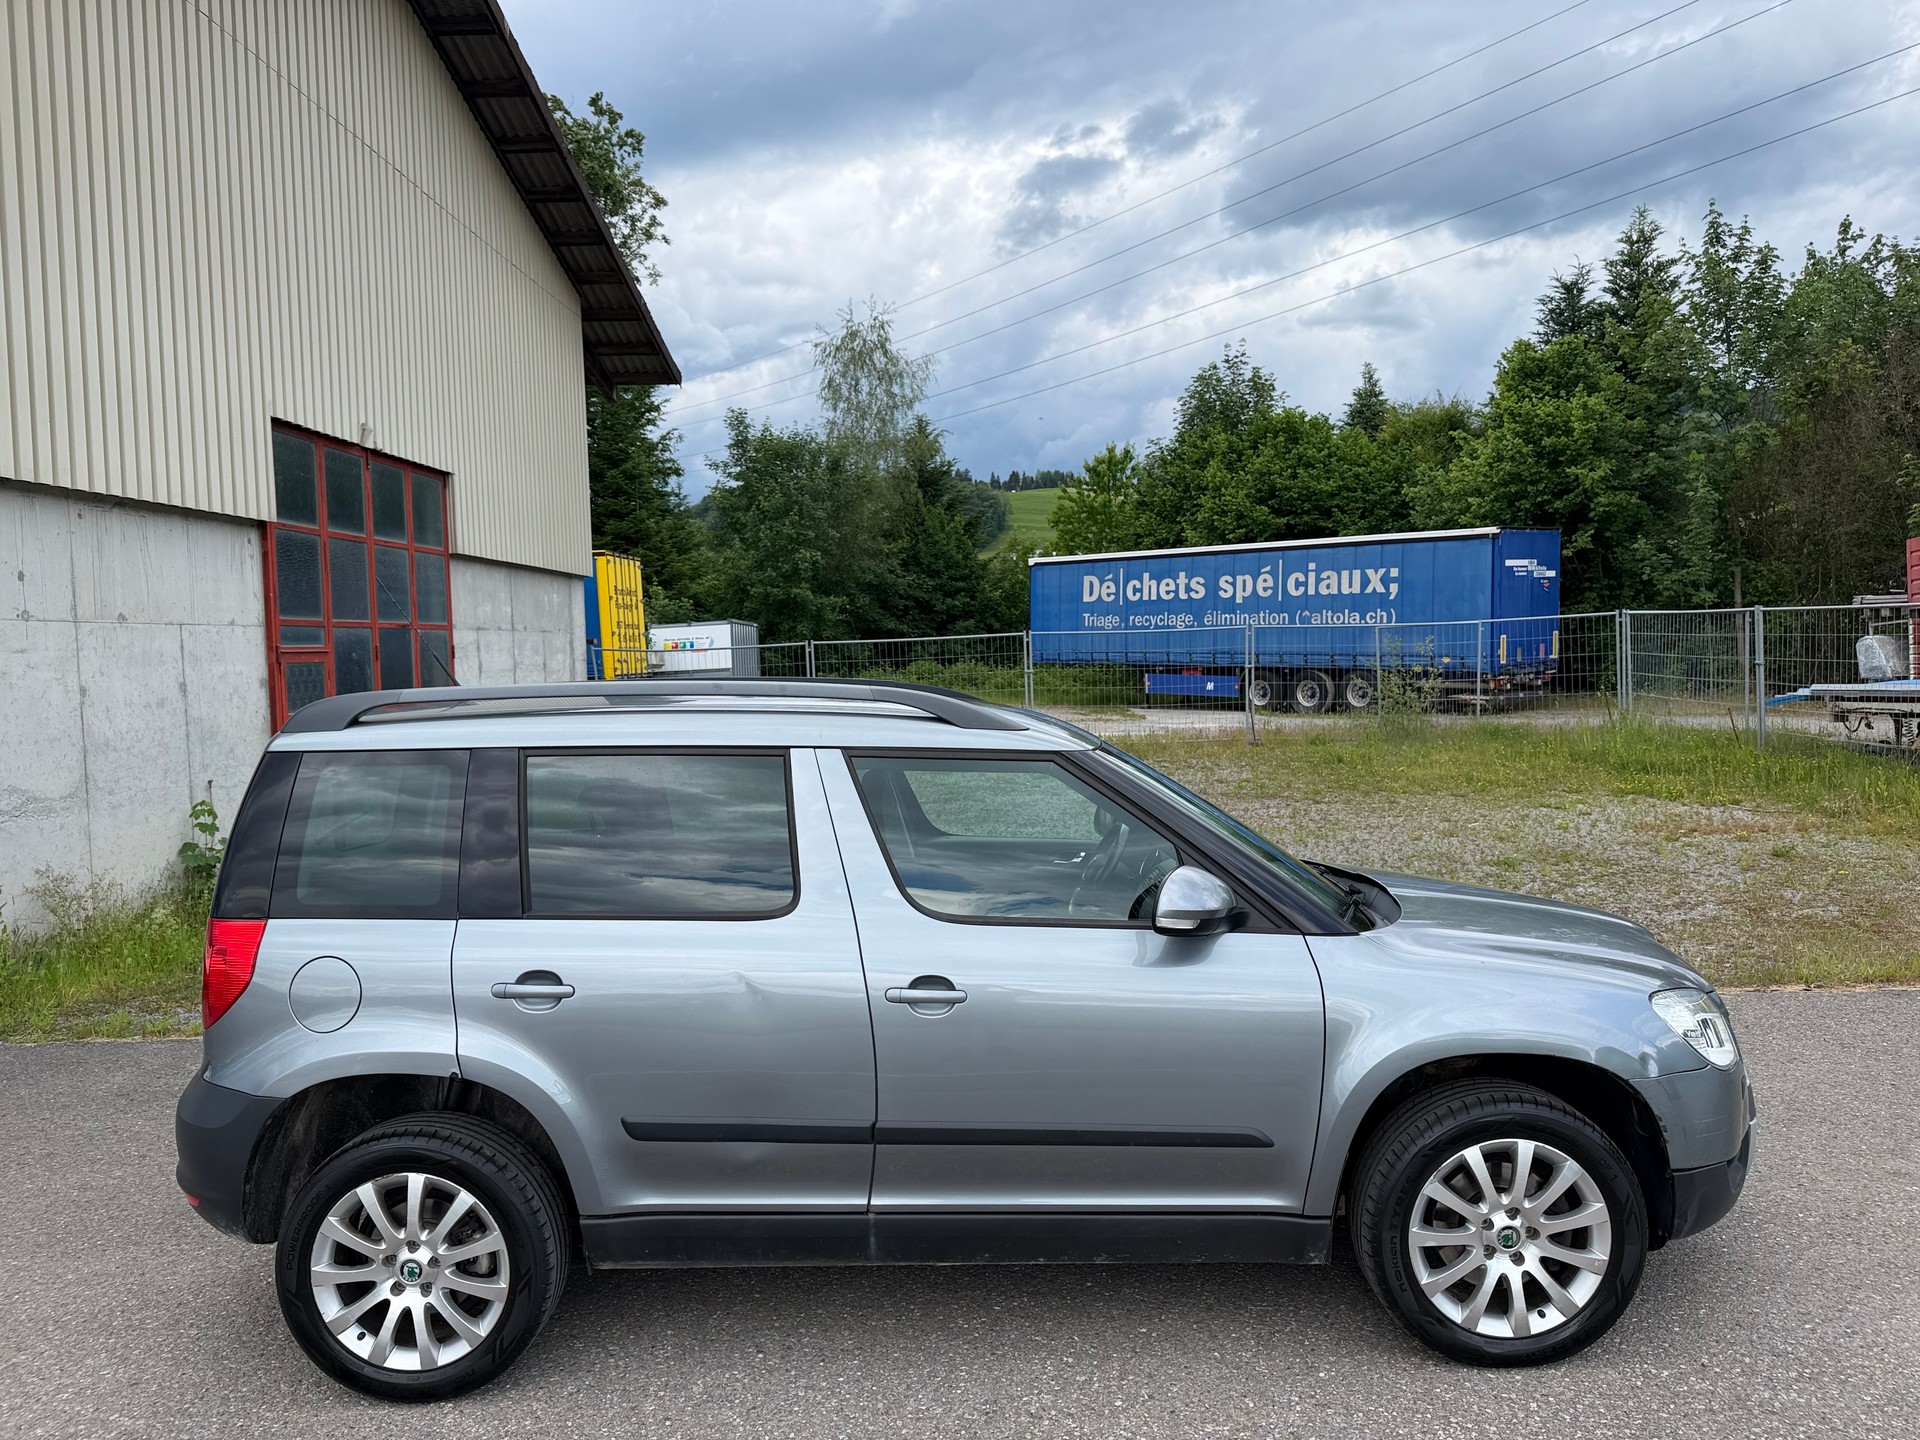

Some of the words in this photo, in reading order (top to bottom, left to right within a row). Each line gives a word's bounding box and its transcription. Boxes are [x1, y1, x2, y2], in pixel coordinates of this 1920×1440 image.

[1082, 613, 1125, 629] Triage,
[1129, 611, 1198, 629] recyclage,
[1204, 610, 1289, 626] élimination
[286, 1190, 322, 1271] POWERPROOF
[1390, 1174, 1415, 1231] TYRES
